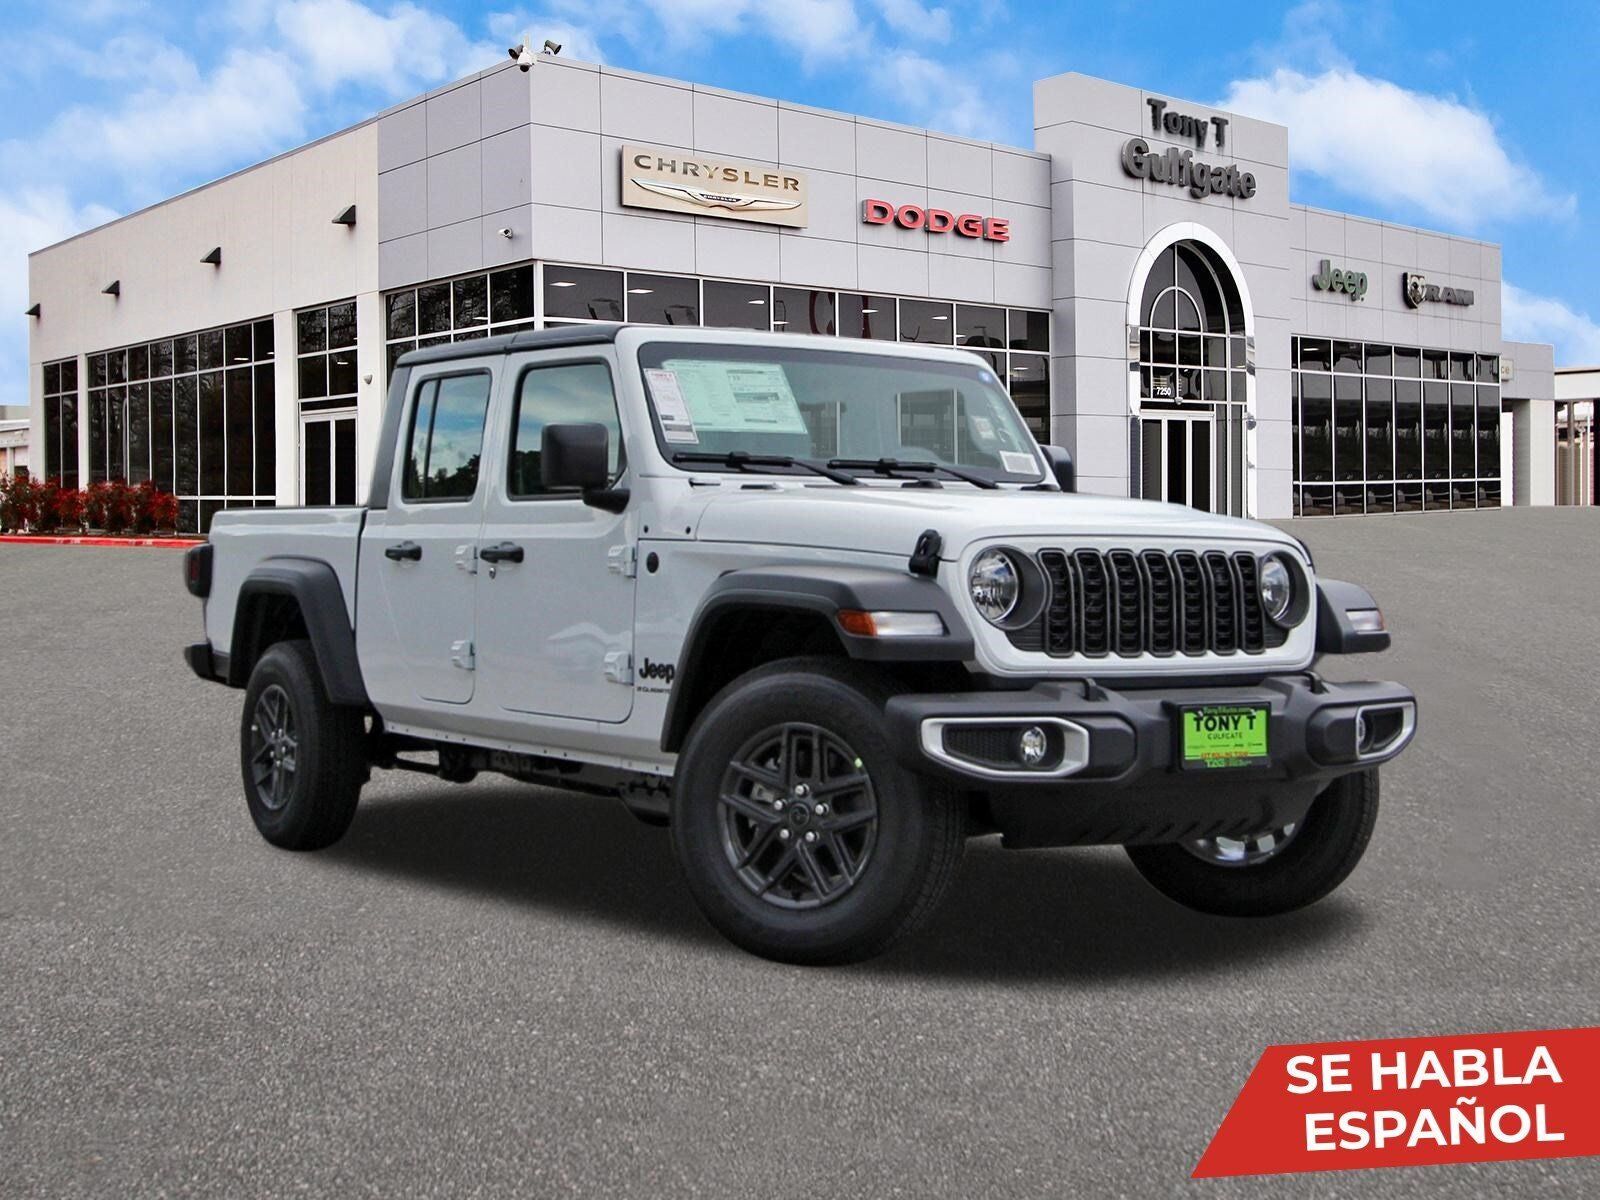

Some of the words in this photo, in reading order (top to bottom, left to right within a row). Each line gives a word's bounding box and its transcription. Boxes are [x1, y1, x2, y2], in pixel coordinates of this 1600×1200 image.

[1146, 98, 1208, 148] Tony
[1210, 116, 1229, 147] T
[633, 154, 800, 192] CHRYSLER
[1121, 138, 1257, 199] Gulfgate
[863, 199, 1010, 243] DODGE
[1312, 259, 1368, 301] Jeep
[1425, 283, 1475, 306] RAM
[1156, 386, 1171, 396] 7250
[639, 657, 675, 684] Jeep
[1193, 714, 1241, 732] TONY
[1246, 714, 1257, 730] T
